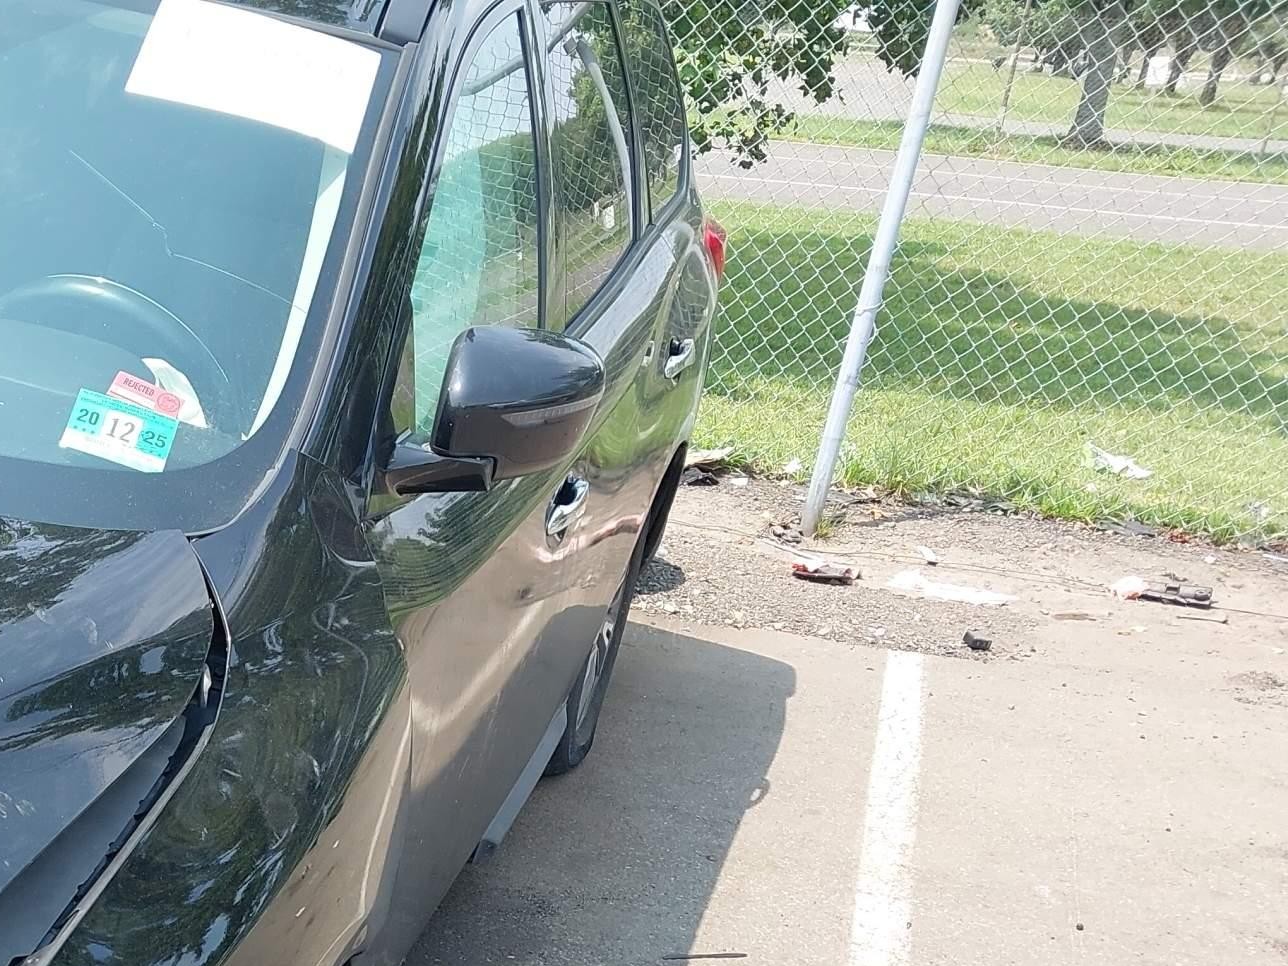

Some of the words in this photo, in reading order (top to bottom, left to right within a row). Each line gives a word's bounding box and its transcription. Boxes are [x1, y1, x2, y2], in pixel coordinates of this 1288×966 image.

[123, 377, 155, 398] REJECTED
[77, 409, 100, 426] 20
[107, 418, 136, 443] 12
[143, 431, 167, 448] 25
